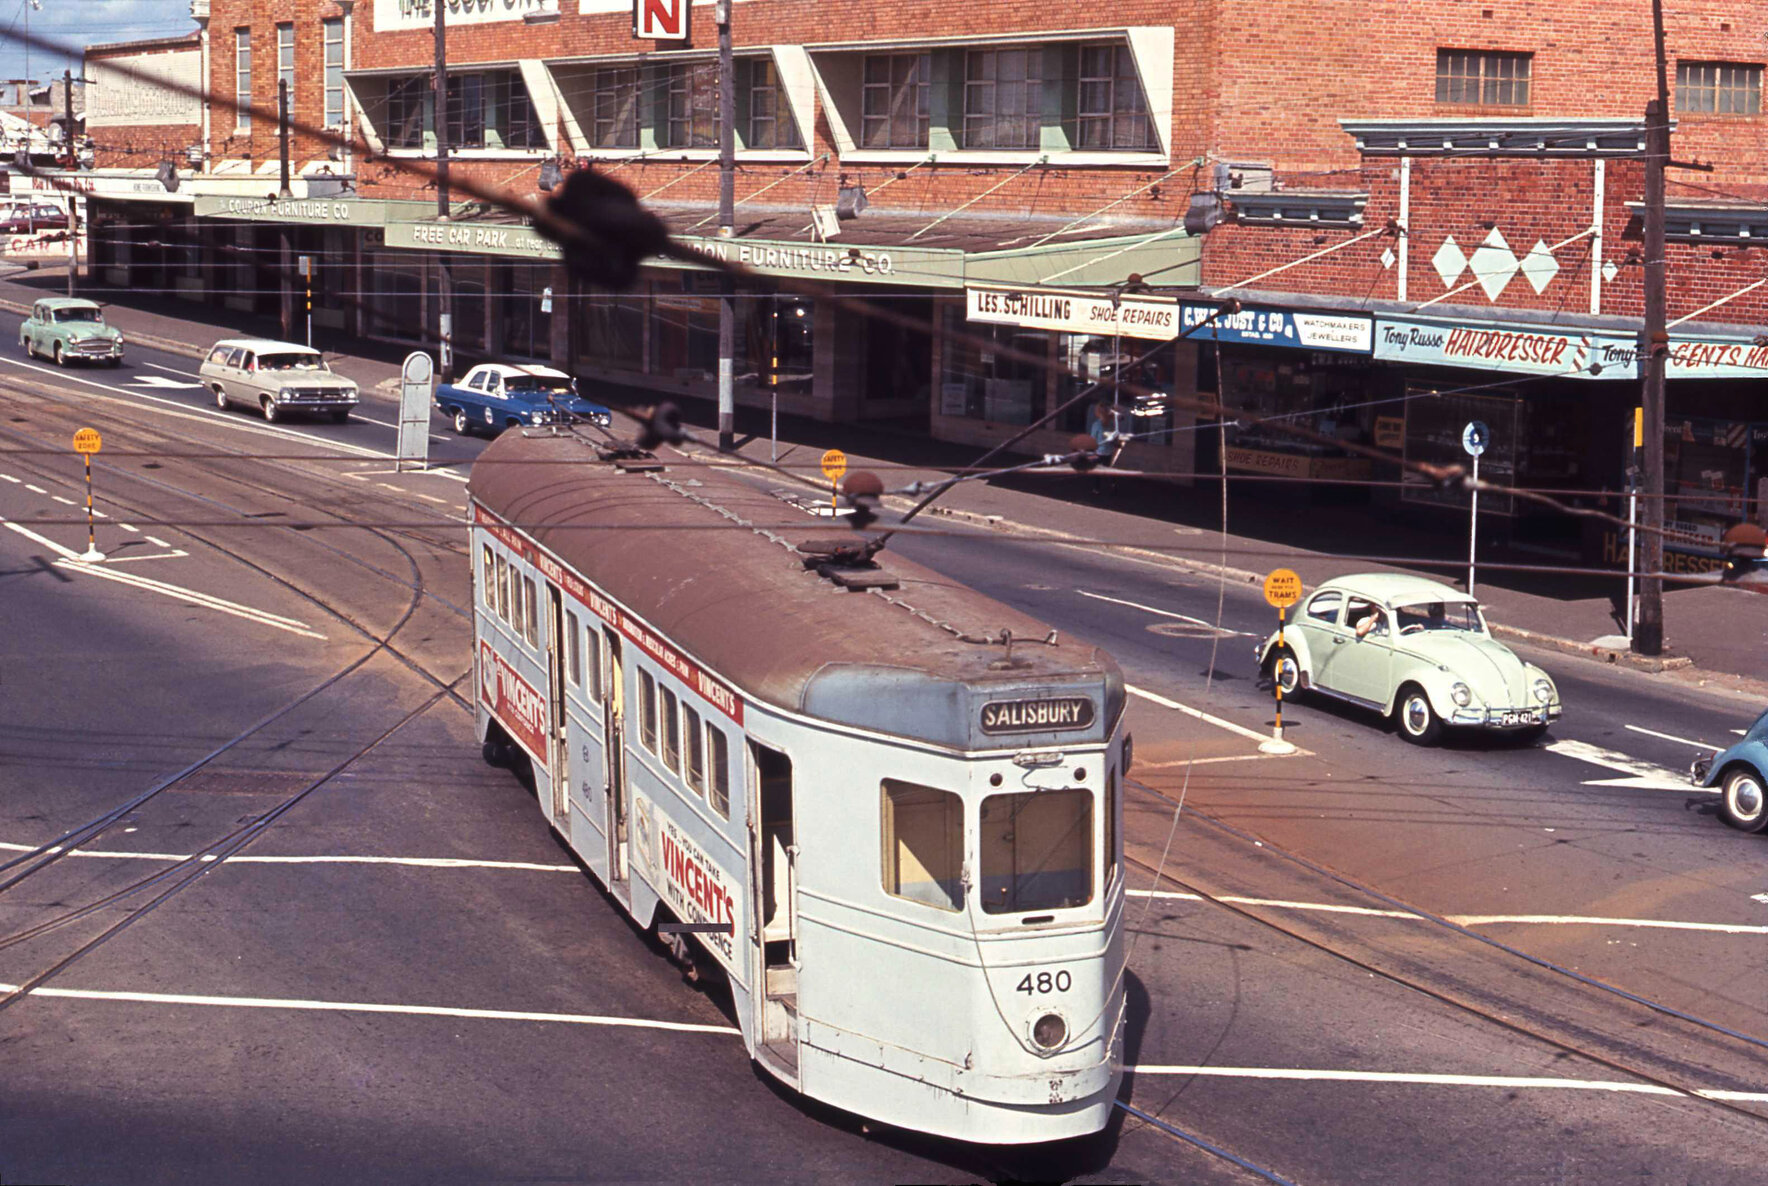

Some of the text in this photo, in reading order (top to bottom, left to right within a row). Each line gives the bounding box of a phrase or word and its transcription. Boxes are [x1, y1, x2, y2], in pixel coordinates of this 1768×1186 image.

[271, 202, 328, 218] FURNITURE
[413, 226, 444, 244] FREE
[449, 228, 470, 245] CAR
[475, 229, 508, 247] PARK
[740, 245, 850, 272] FURNITURE
[863, 253, 896, 275] CO.
[1003, 295, 1071, 320] SCHILLING
[1090, 305, 1118, 322] SHOE
[1122, 309, 1172, 327] REPAIRS
[1224, 310, 1255, 330] JUST
[1303, 318, 1366, 332] WATCHMAKERS
[1307, 332, 1358, 344] JEWELLERS
[1383, 326, 1569, 366] Tony Russo HAIRDRESSER
[1602, 344, 1634, 369] Tony
[1673, 341, 1742, 368] GENTS
[1227, 449, 1252, 465] SHOE
[1269, 590, 1297, 599] TRAMS
[985, 700, 1082, 727] SALISBURY
[693, 847, 703, 866] CAN
[705, 857, 720, 882] TAKE
[661, 830, 735, 939] VINCENT'S
[666, 877, 685, 911] WITH
[1016, 969, 1072, 996] 480
